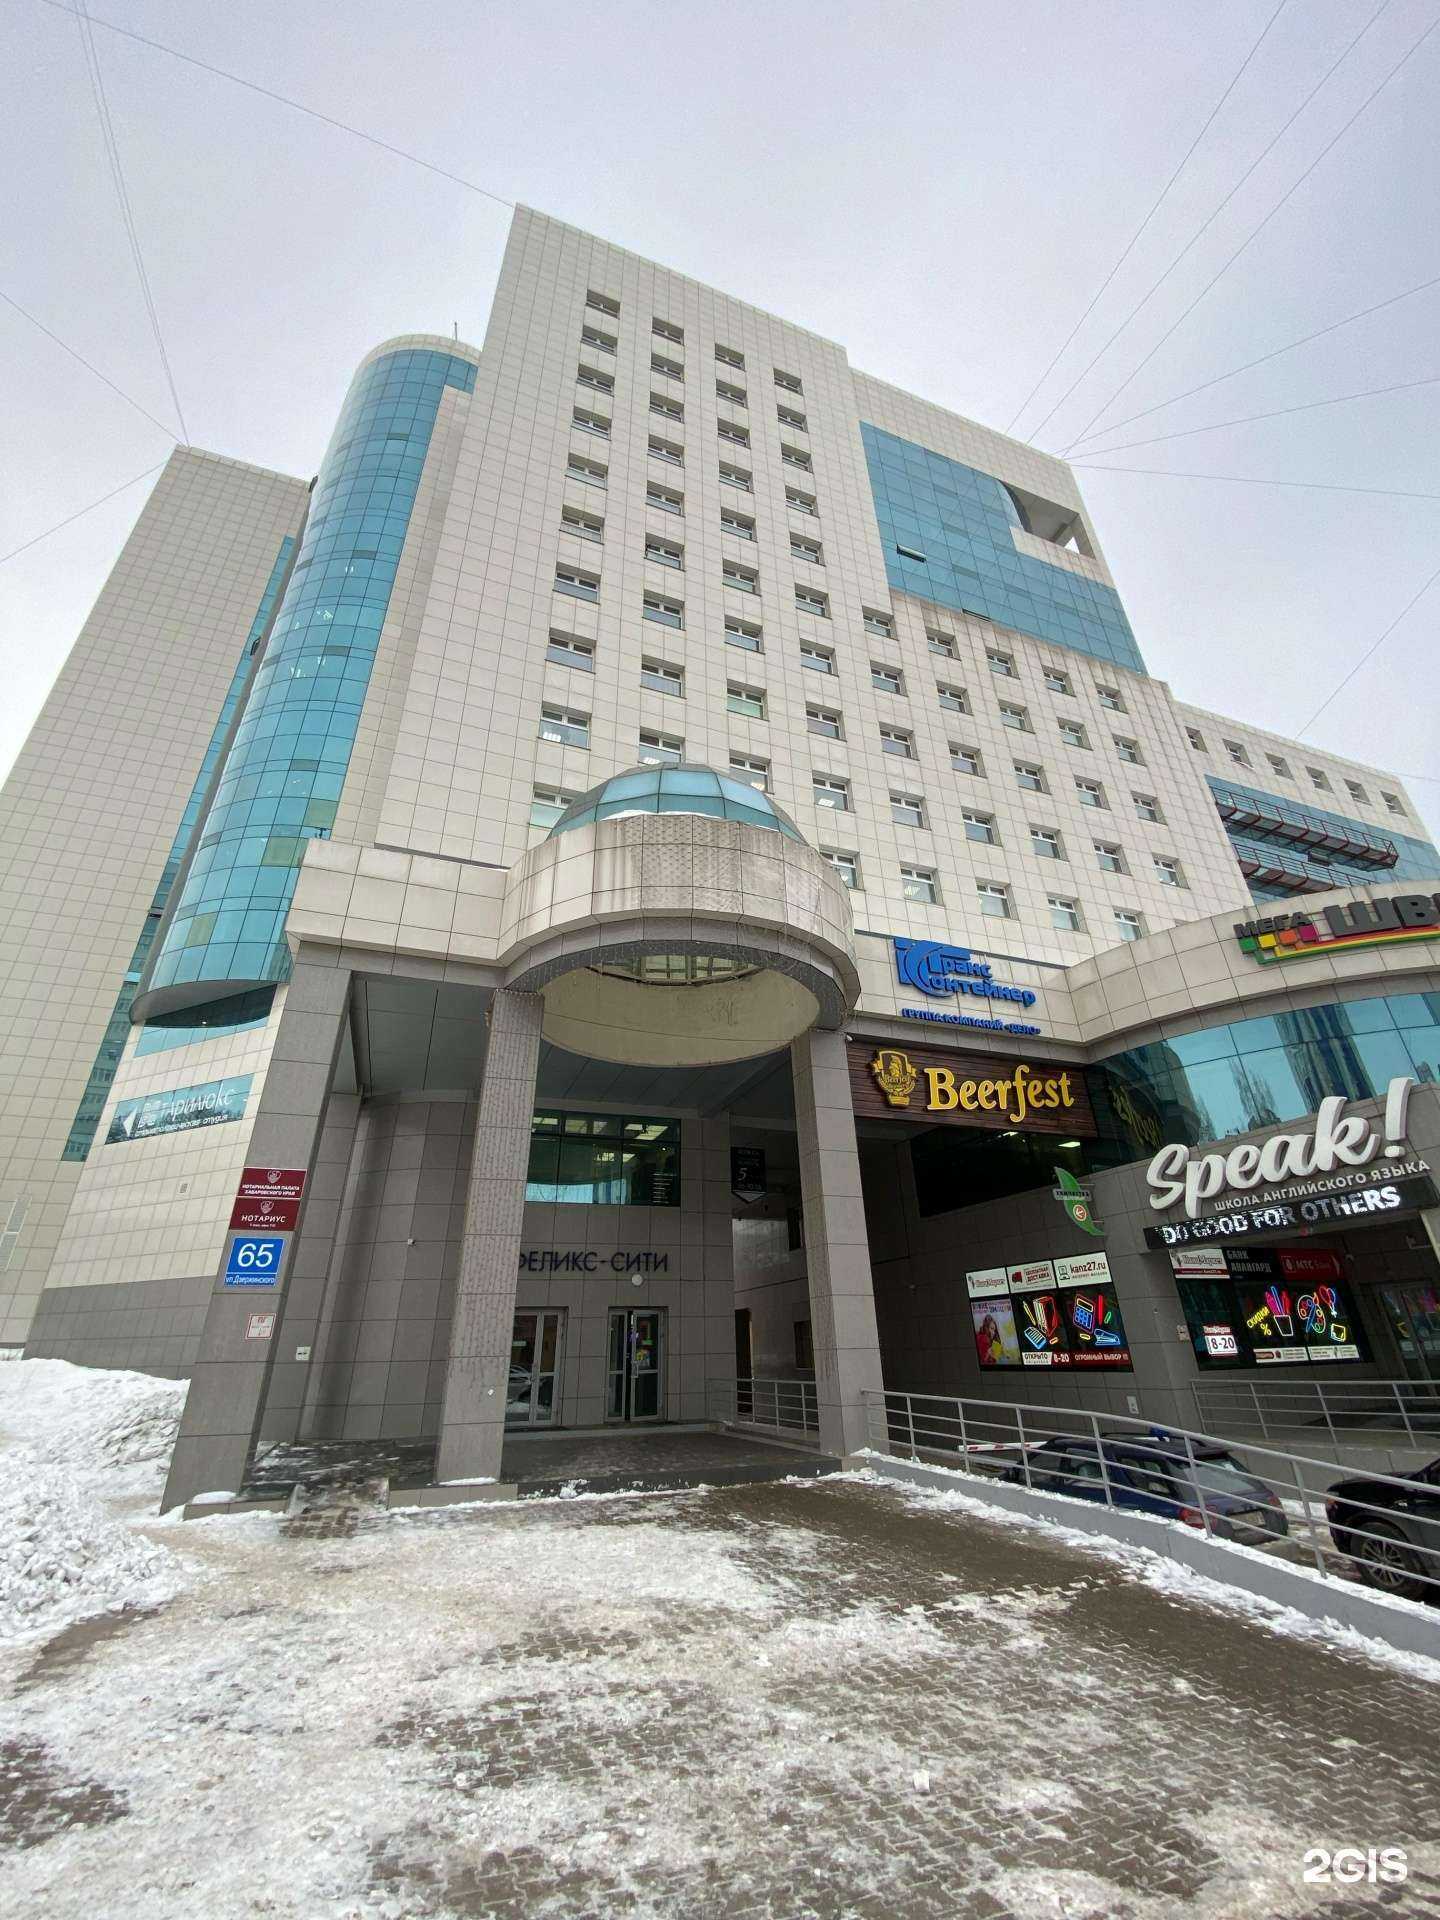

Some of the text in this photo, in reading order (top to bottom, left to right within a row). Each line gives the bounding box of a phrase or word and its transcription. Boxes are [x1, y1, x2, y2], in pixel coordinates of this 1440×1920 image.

[1233, 893, 1440, 939] МЕГА ШВ
[901, 1008, 942, 1023] ГРУППА
[942, 1013, 1003, 1031] КОМПАНИЙ
[924, 1064, 1074, 1122] Beerfest
[1147, 1077, 1414, 1218] Speak!
[1214, 1160, 1431, 1211] ШКОЛА АНГЛИЙСКОГО ЯЗЫКА
[1300, 1185, 1402, 1222] OTHERS
[241, 1214, 287, 1223] НОТАРИУС
[237, 1243, 275, 1268] 65
[1070, 1261, 1106, 1274] kanz27.ru
[1211, 1337, 1235, 1350] 8-20
[1053, 1353, 1070, 1363] 8-20
[1074, 1352, 1103, 1361] ОГРОМНЫЙ
[1103, 1352, 1122, 1360] ВЫБОР
